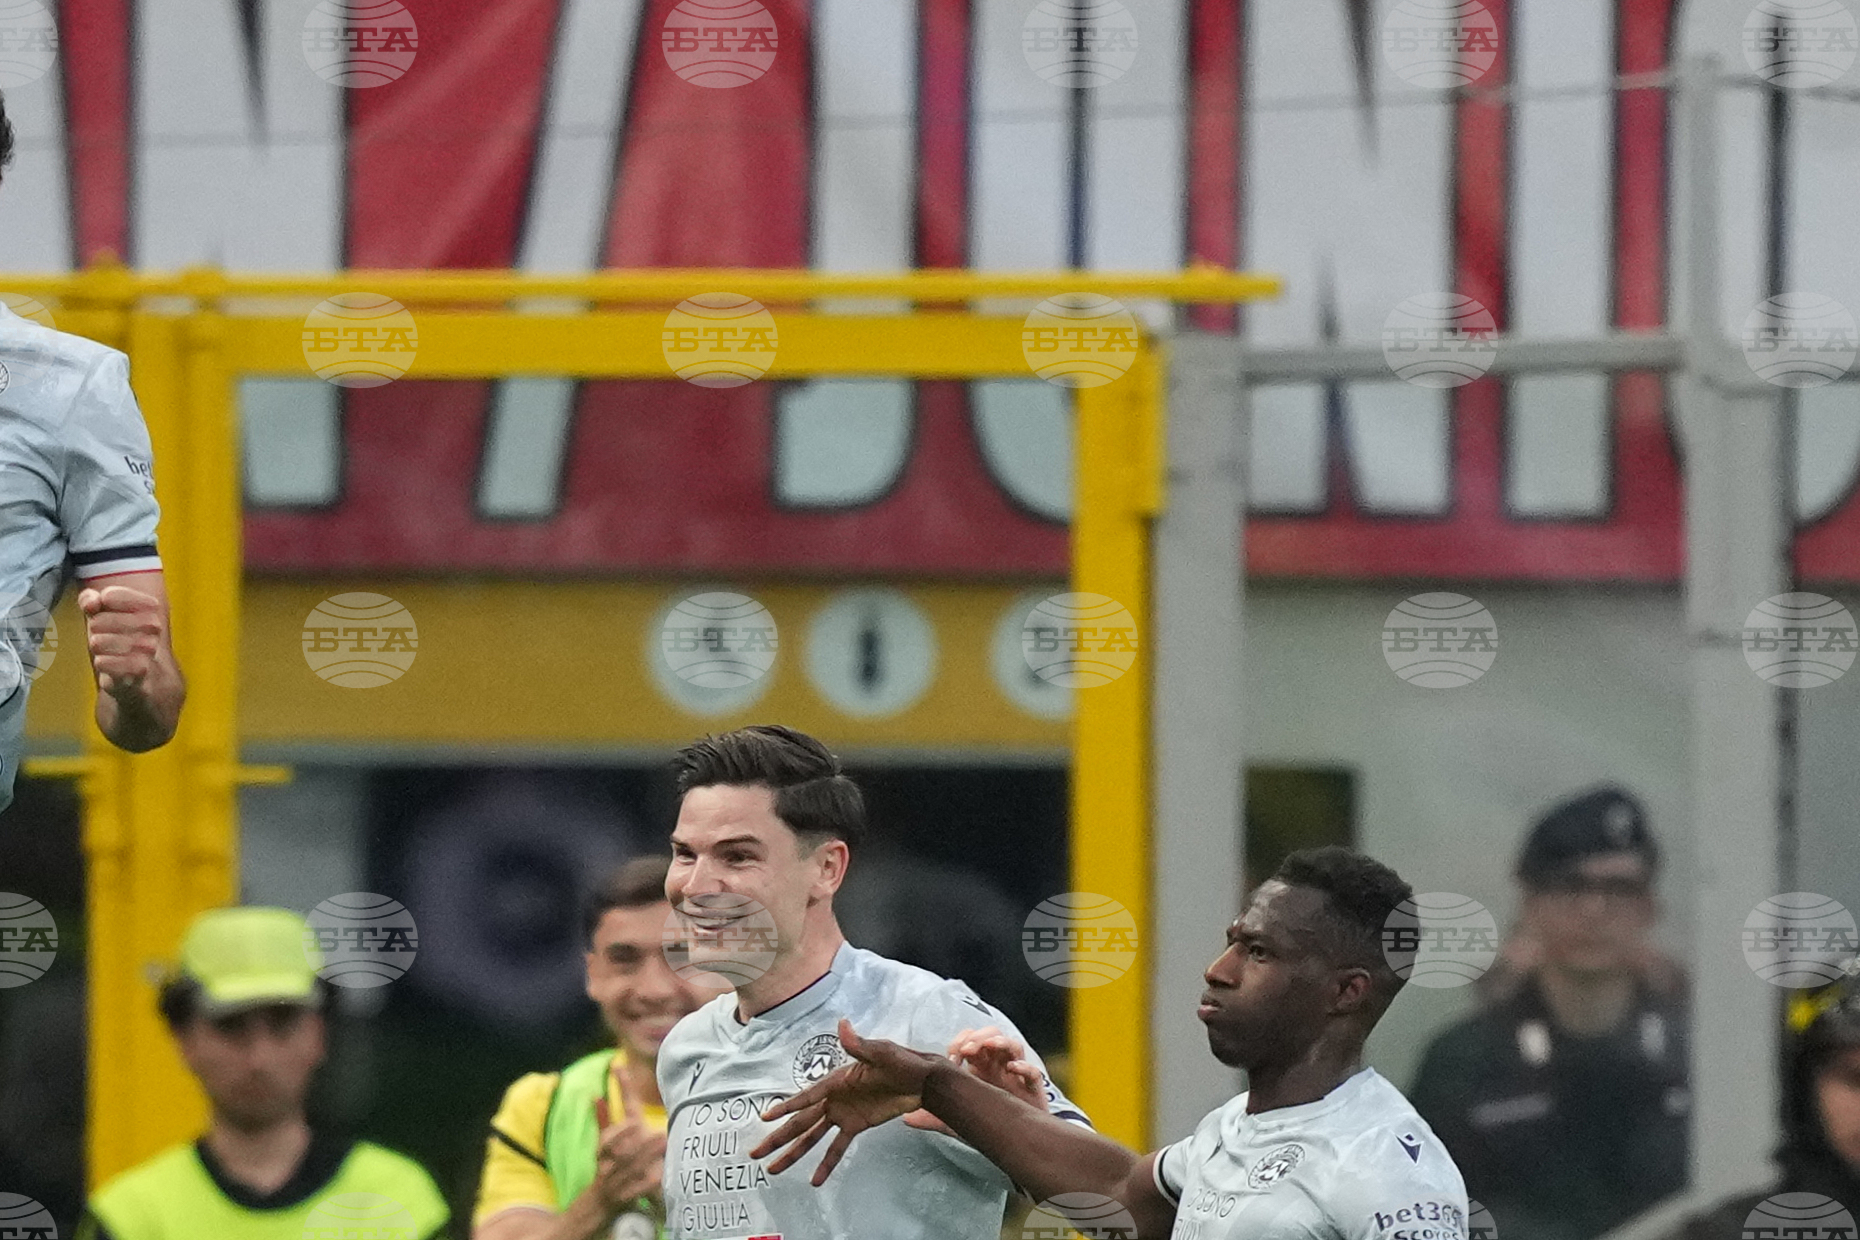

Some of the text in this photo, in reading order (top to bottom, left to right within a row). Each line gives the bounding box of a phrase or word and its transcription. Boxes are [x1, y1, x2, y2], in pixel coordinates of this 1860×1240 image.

[688, 1103, 713, 1127] IO
[682, 1131, 738, 1161] FRIULI
[679, 1164, 770, 1196] VENEZIA
[682, 1203, 752, 1234] GIULIA
